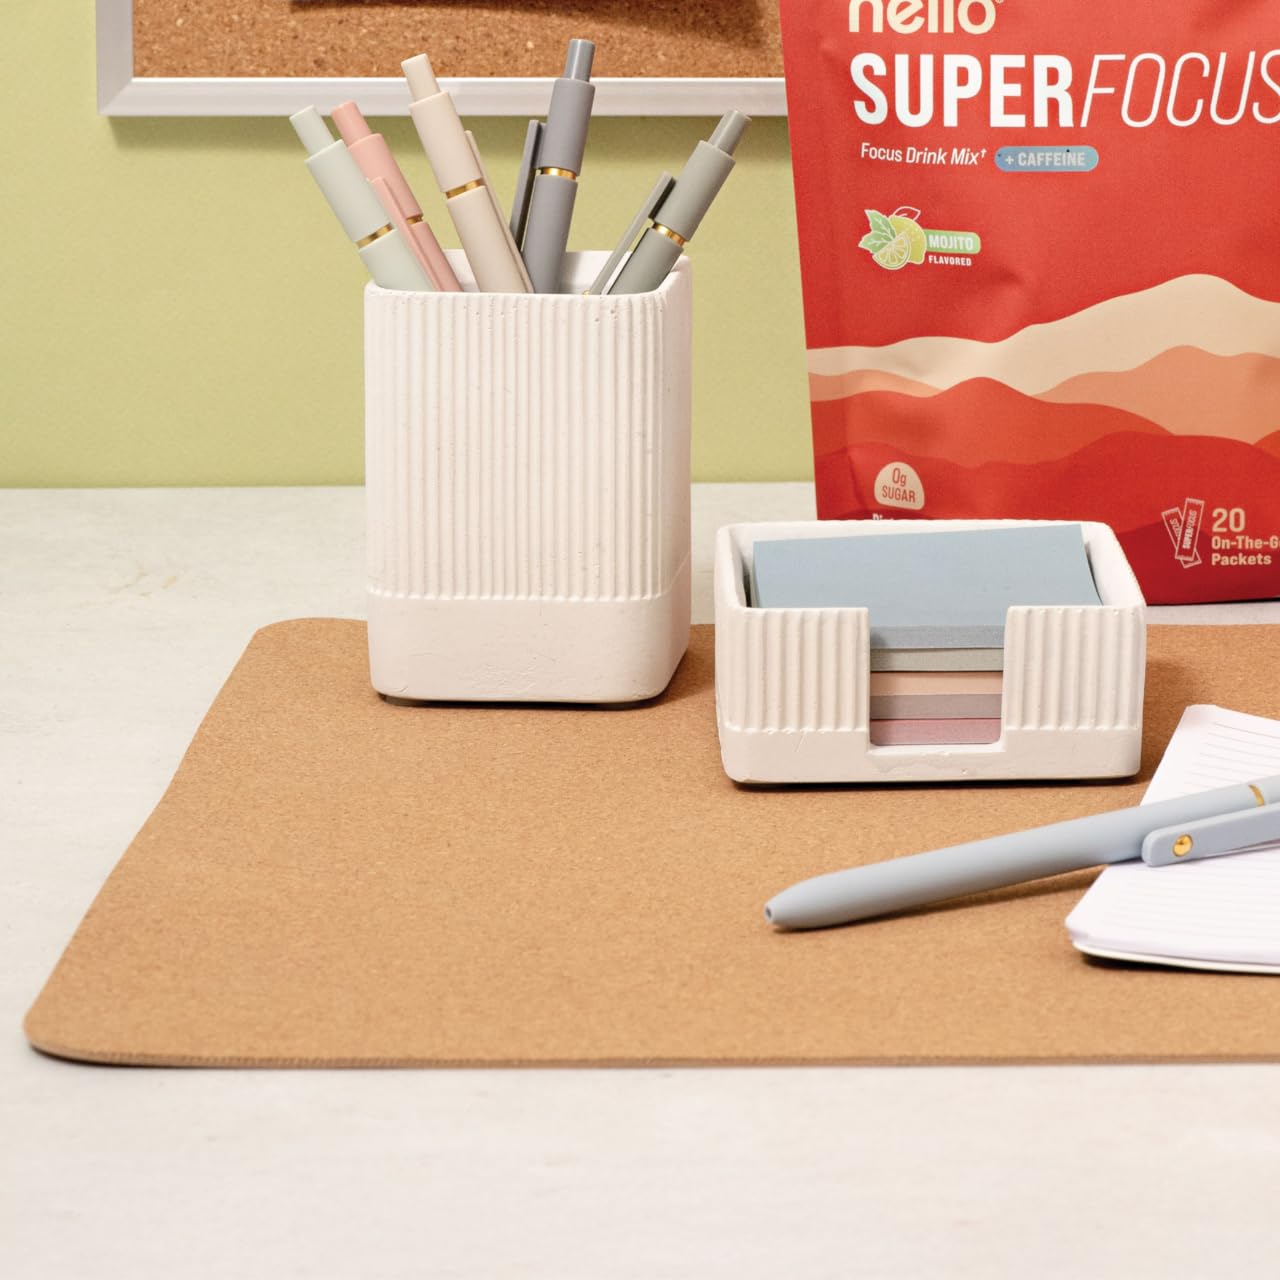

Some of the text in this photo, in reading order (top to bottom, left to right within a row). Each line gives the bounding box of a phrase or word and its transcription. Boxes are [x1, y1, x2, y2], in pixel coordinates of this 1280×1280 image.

[861, 142, 903, 162] Focus
[906, 147, 948, 166] Drink
[1018, 151, 1085, 167] CAFFEINE
[928, 234, 974, 251] MOJITO
[928, 255, 972, 267] FLAVORED
[882, 485, 916, 503] SUGAR
[1211, 507, 1246, 533] 20
[1211, 552, 1272, 566] Packets
